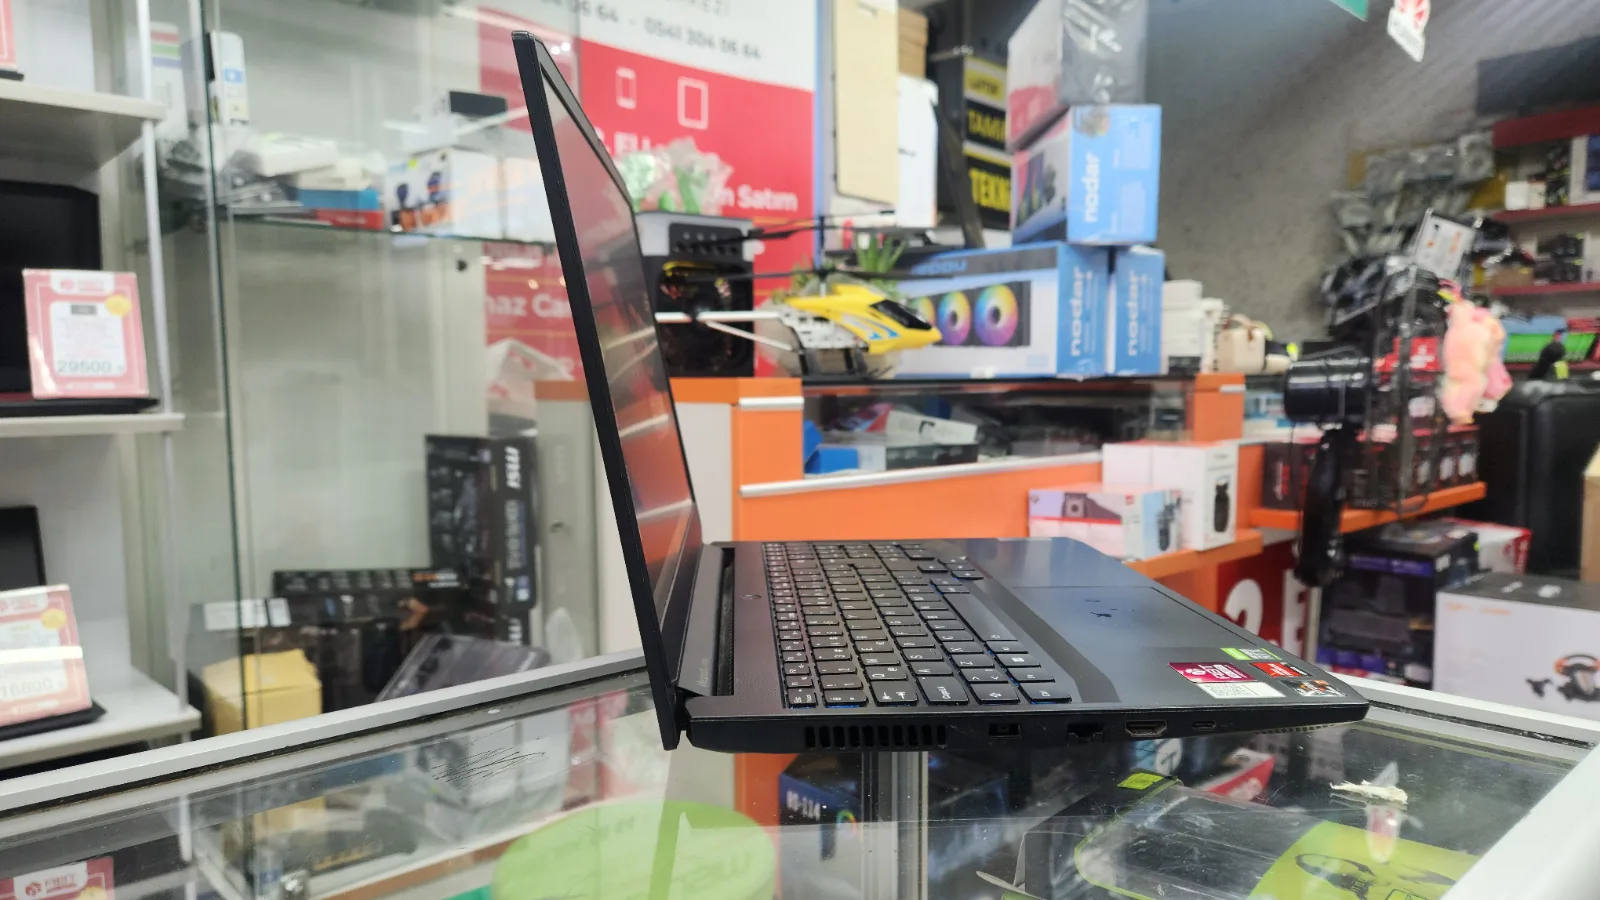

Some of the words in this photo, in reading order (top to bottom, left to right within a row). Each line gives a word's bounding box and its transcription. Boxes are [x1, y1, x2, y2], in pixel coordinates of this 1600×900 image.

[1081, 151, 1099, 223] nodar
[1070, 264, 1084, 357] nodar
[1127, 269, 1140, 357] nodar
[504, 446, 521, 489] MSI
